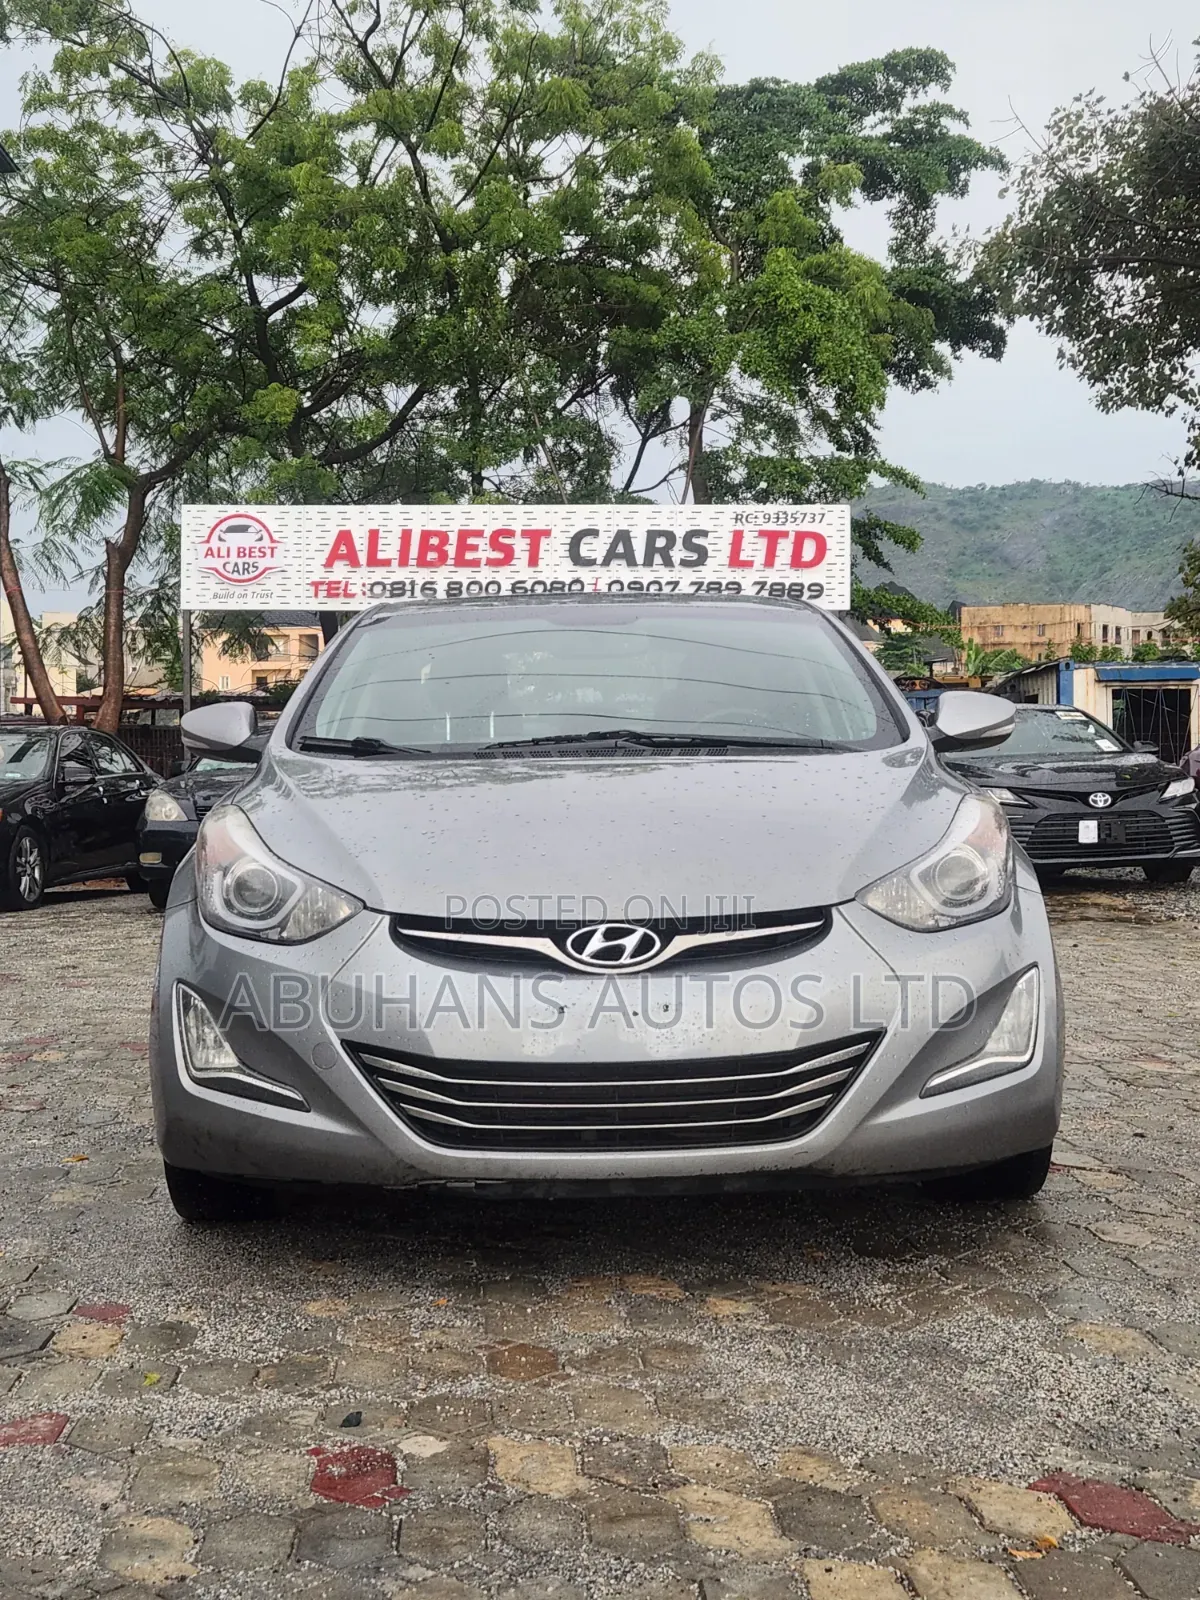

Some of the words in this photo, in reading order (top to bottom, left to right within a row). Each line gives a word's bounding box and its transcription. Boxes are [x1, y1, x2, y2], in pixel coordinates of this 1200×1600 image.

[762, 512, 826, 524] 9335737
[203, 546, 231, 559] ALI
[236, 546, 278, 559] BEST
[323, 528, 552, 569] ALIBEST
[568, 528, 710, 568] CARS
[727, 529, 828, 570] LTD
[222, 561, 260, 576] CARS
[212, 591, 236, 600] Build
[236, 592, 248, 600] on
[250, 591, 274, 600] Trust
[445, 580, 502, 599] 800
[751, 580, 825, 600] 7889
